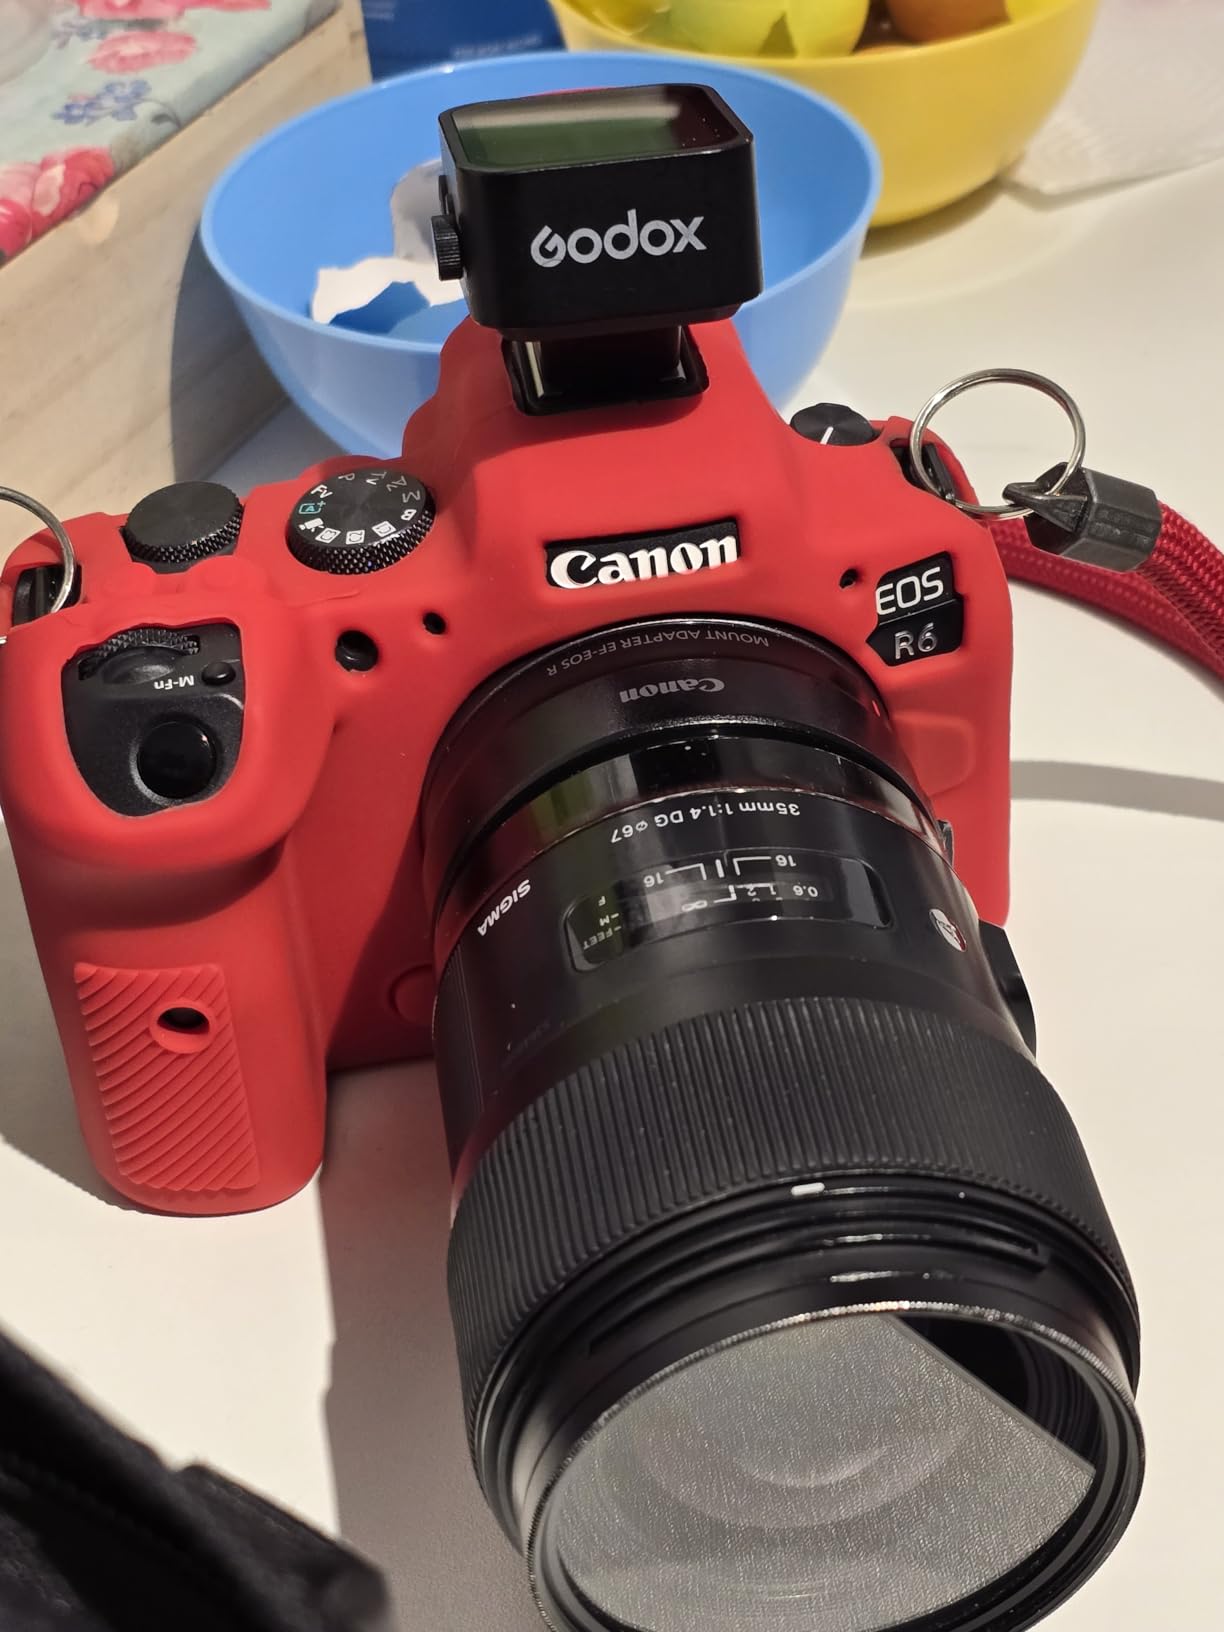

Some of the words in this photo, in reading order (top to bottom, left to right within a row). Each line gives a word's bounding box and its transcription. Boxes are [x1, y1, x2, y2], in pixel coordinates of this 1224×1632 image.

[531, 208, 707, 268] Godox
[366, 471, 387, 485] Tv
[386, 475, 408, 492] Av
[310, 484, 333, 498] Fv
[402, 490, 420, 503] M
[400, 509, 417, 521] B
[550, 536, 738, 589] Canon
[875, 566, 944, 615] EOS
[622, 629, 701, 649] ADAPTER
[704, 629, 770, 648] MOUNT
[894, 622, 937, 660] R6
[560, 640, 617, 670] EF-EOS
[546, 664, 557, 677] R
[154, 675, 195, 690] M-Fn
[619, 678, 725, 704] Canon
[690, 802, 733, 820] 1:1.4
[738, 801, 801, 817] 35mm
[655, 810, 684, 828] DG
[774, 854, 797, 867] 16
[643, 873, 664, 888] 16
[792, 884, 819, 898] 0.6
[477, 879, 532, 936] SIGMA
[583, 928, 613, 950] FEET
